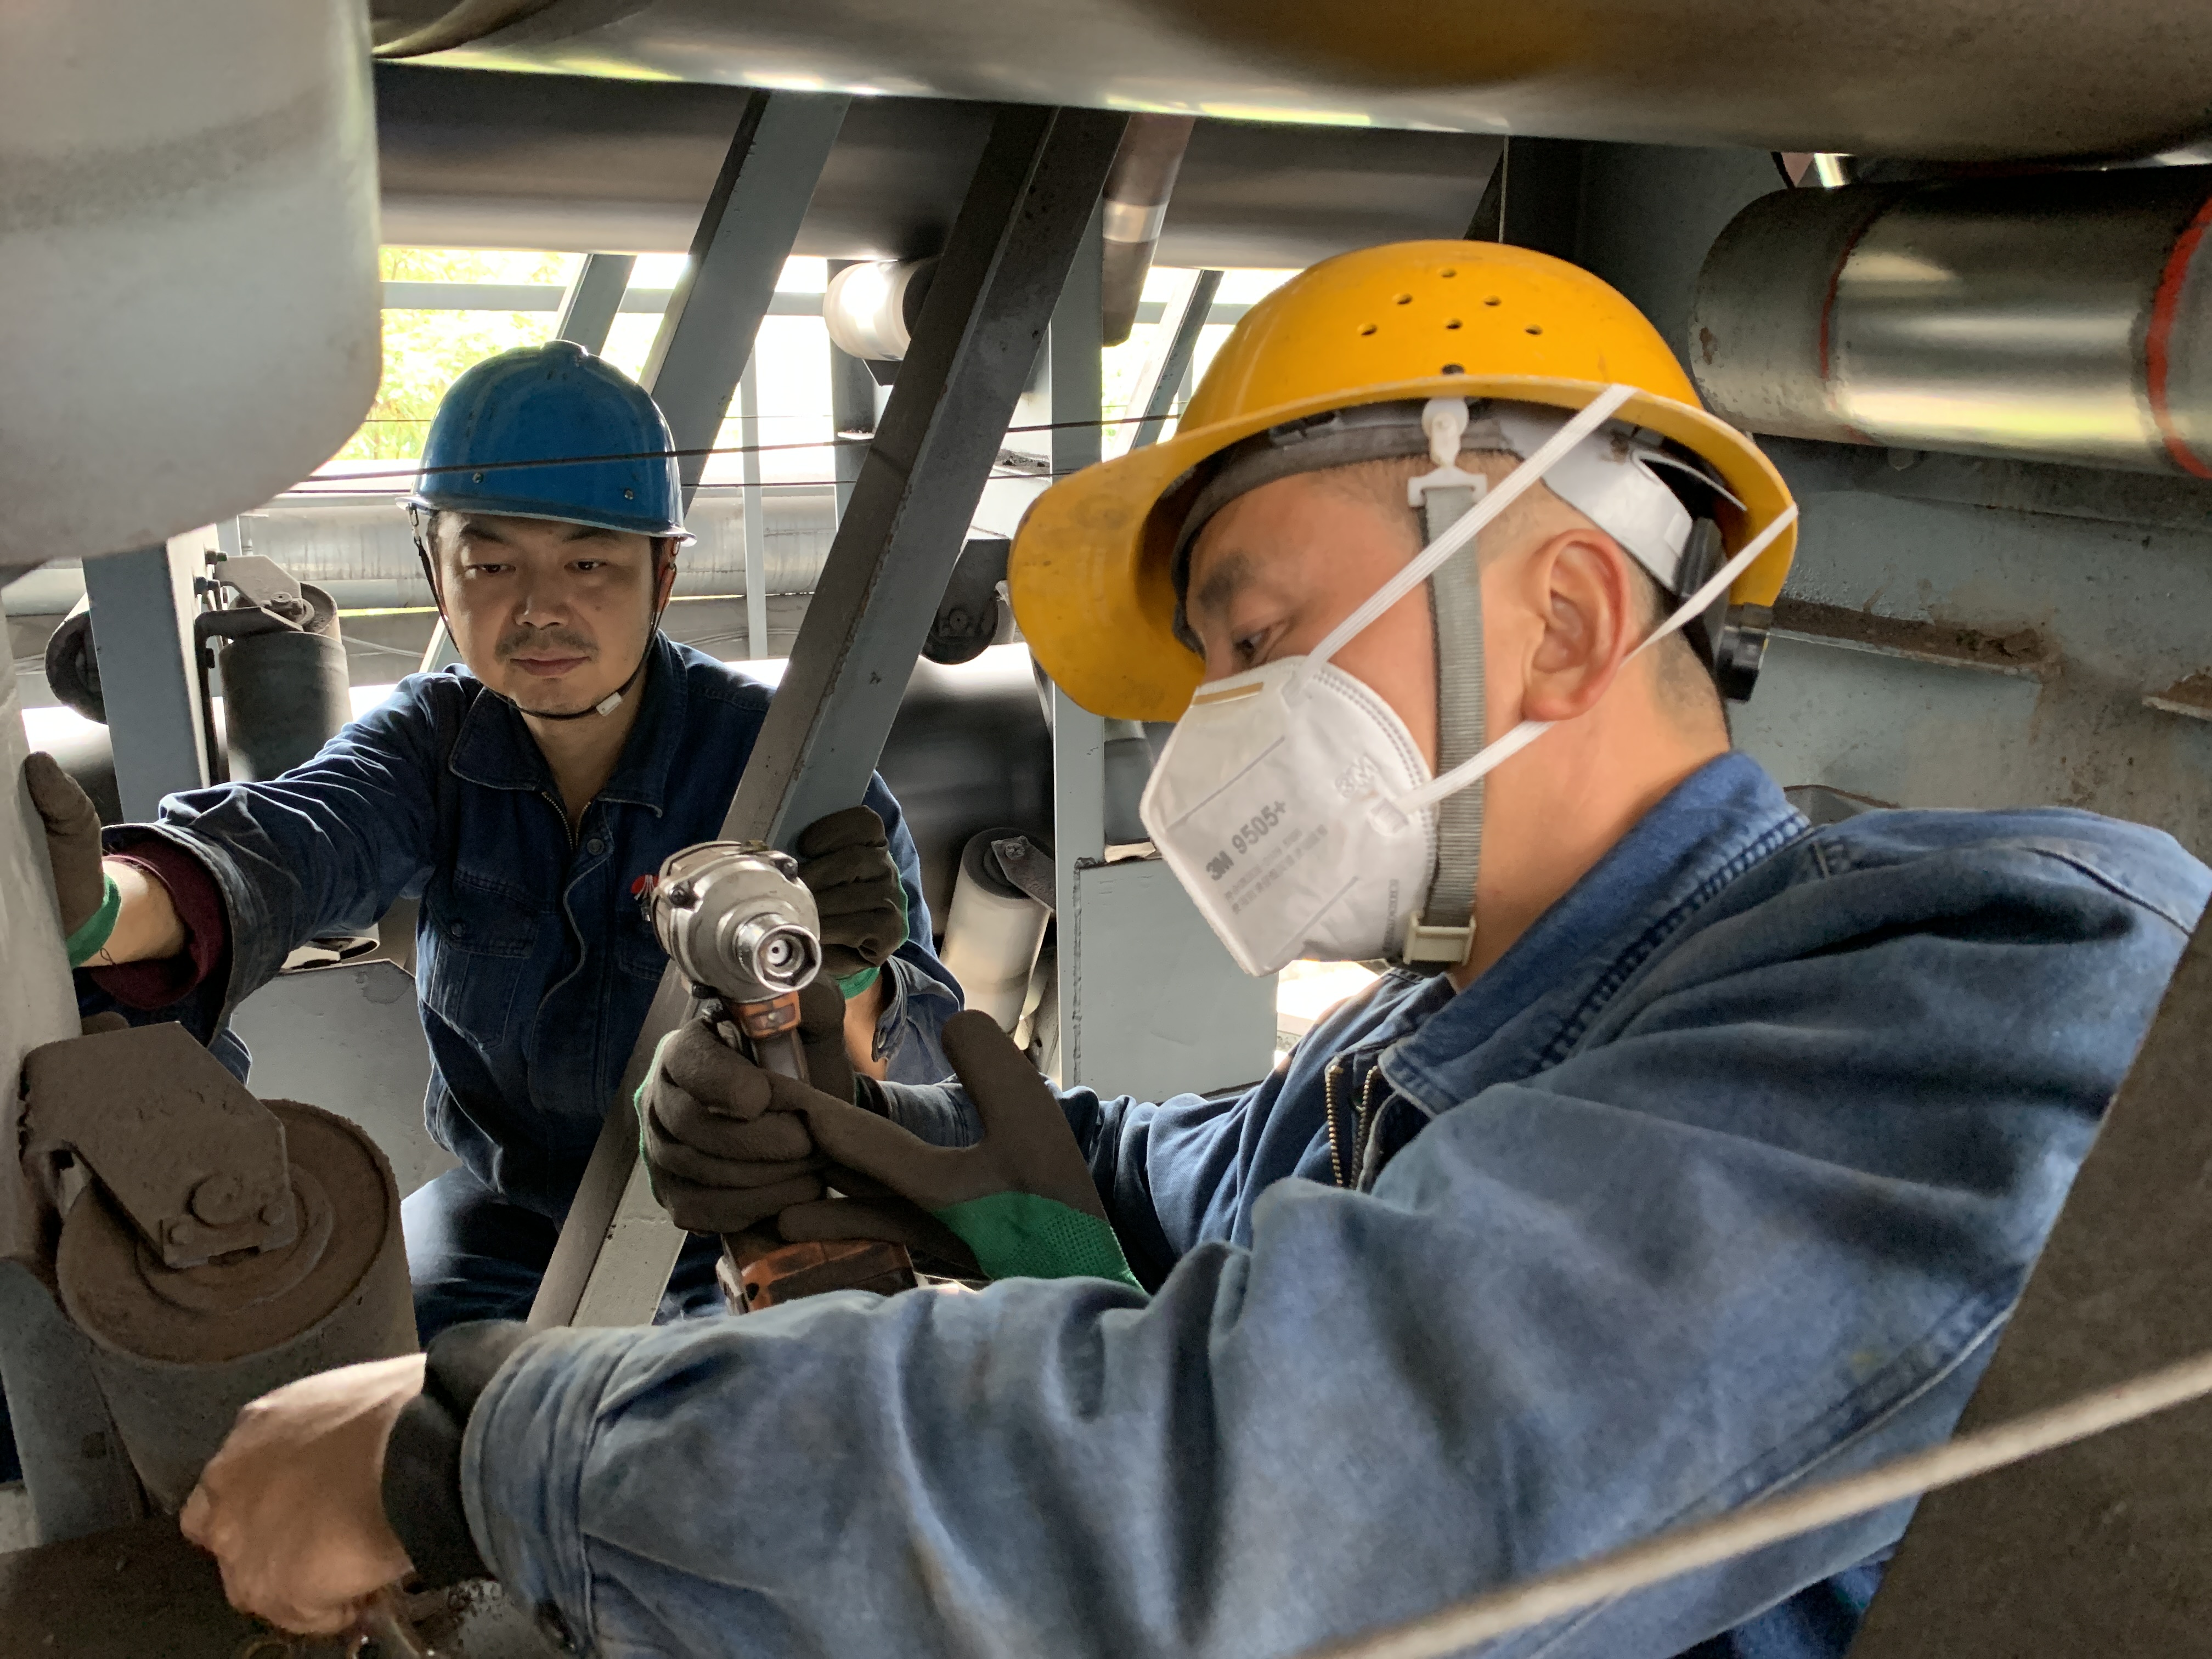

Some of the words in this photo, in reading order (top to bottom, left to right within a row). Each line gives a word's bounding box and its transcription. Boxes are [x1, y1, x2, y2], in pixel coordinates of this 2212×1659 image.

[1335, 754, 1380, 798] 3M
[1206, 850, 1234, 881] 3M
[1232, 800, 1286, 854] 9505+
